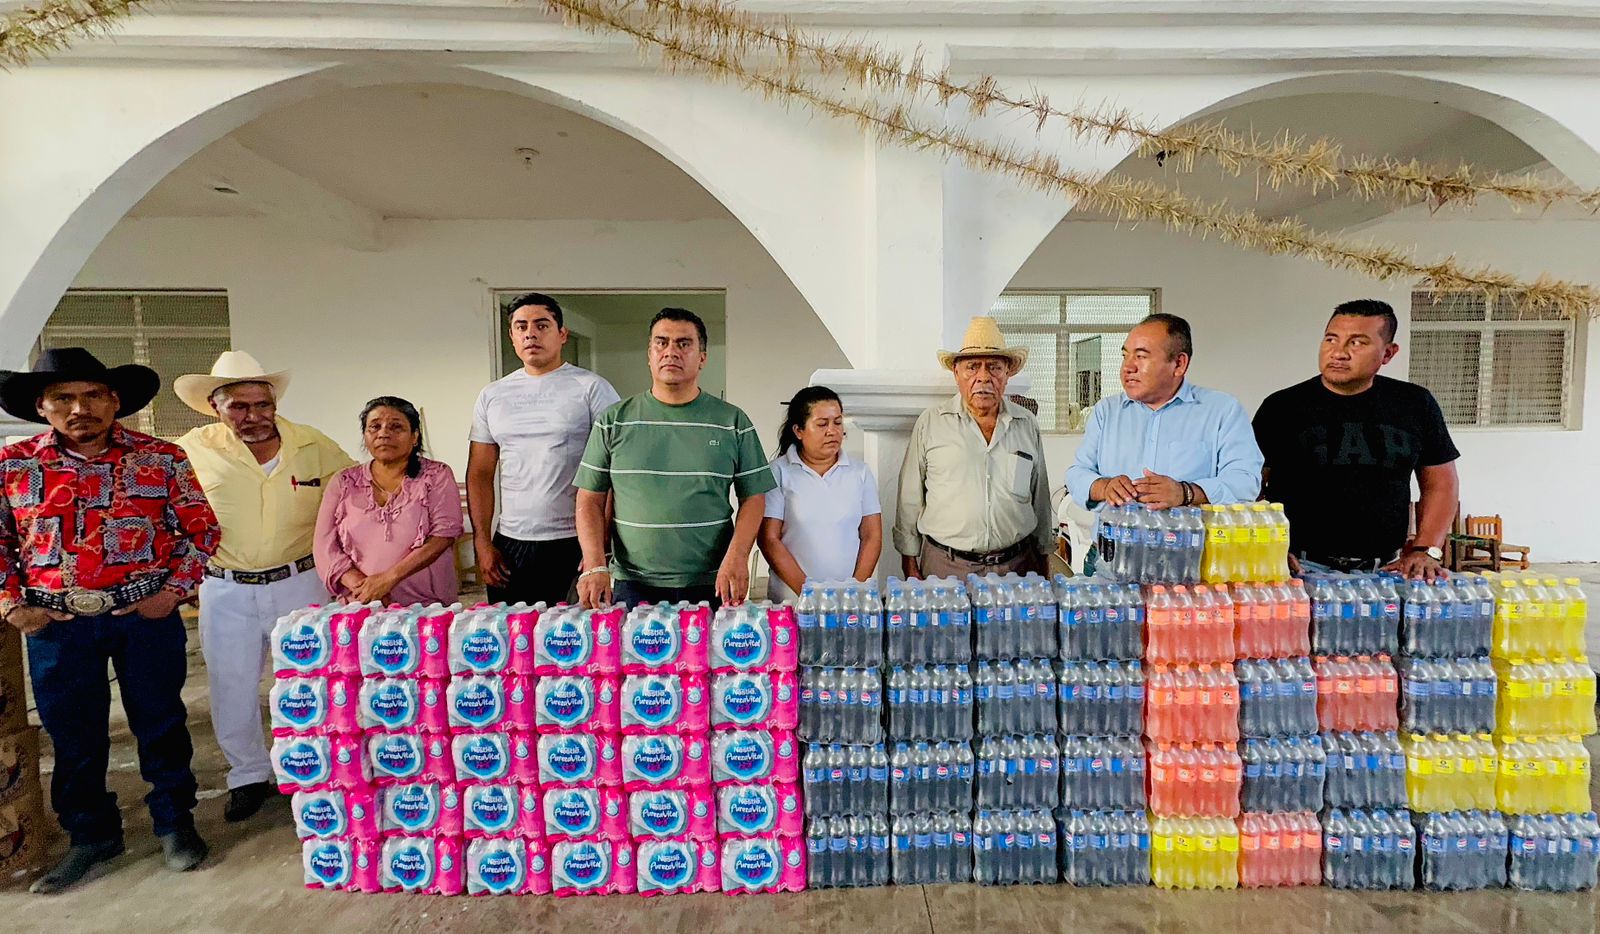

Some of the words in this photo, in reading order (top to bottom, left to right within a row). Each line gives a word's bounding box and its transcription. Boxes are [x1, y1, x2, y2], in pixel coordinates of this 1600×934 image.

[1301, 422, 1412, 467] GAP
[328, 664, 340, 672] 12
[587, 663, 599, 673] 12
[675, 662, 686, 671] 12
[765, 664, 776, 672] 12
[415, 724, 427, 732] 12
[501, 721, 513, 730] 12
[588, 721, 600, 729] 12
[676, 722, 688, 731] 12
[766, 719, 777, 728] 12
[322, 724, 335, 733] 12
[678, 777, 688, 785] 12
